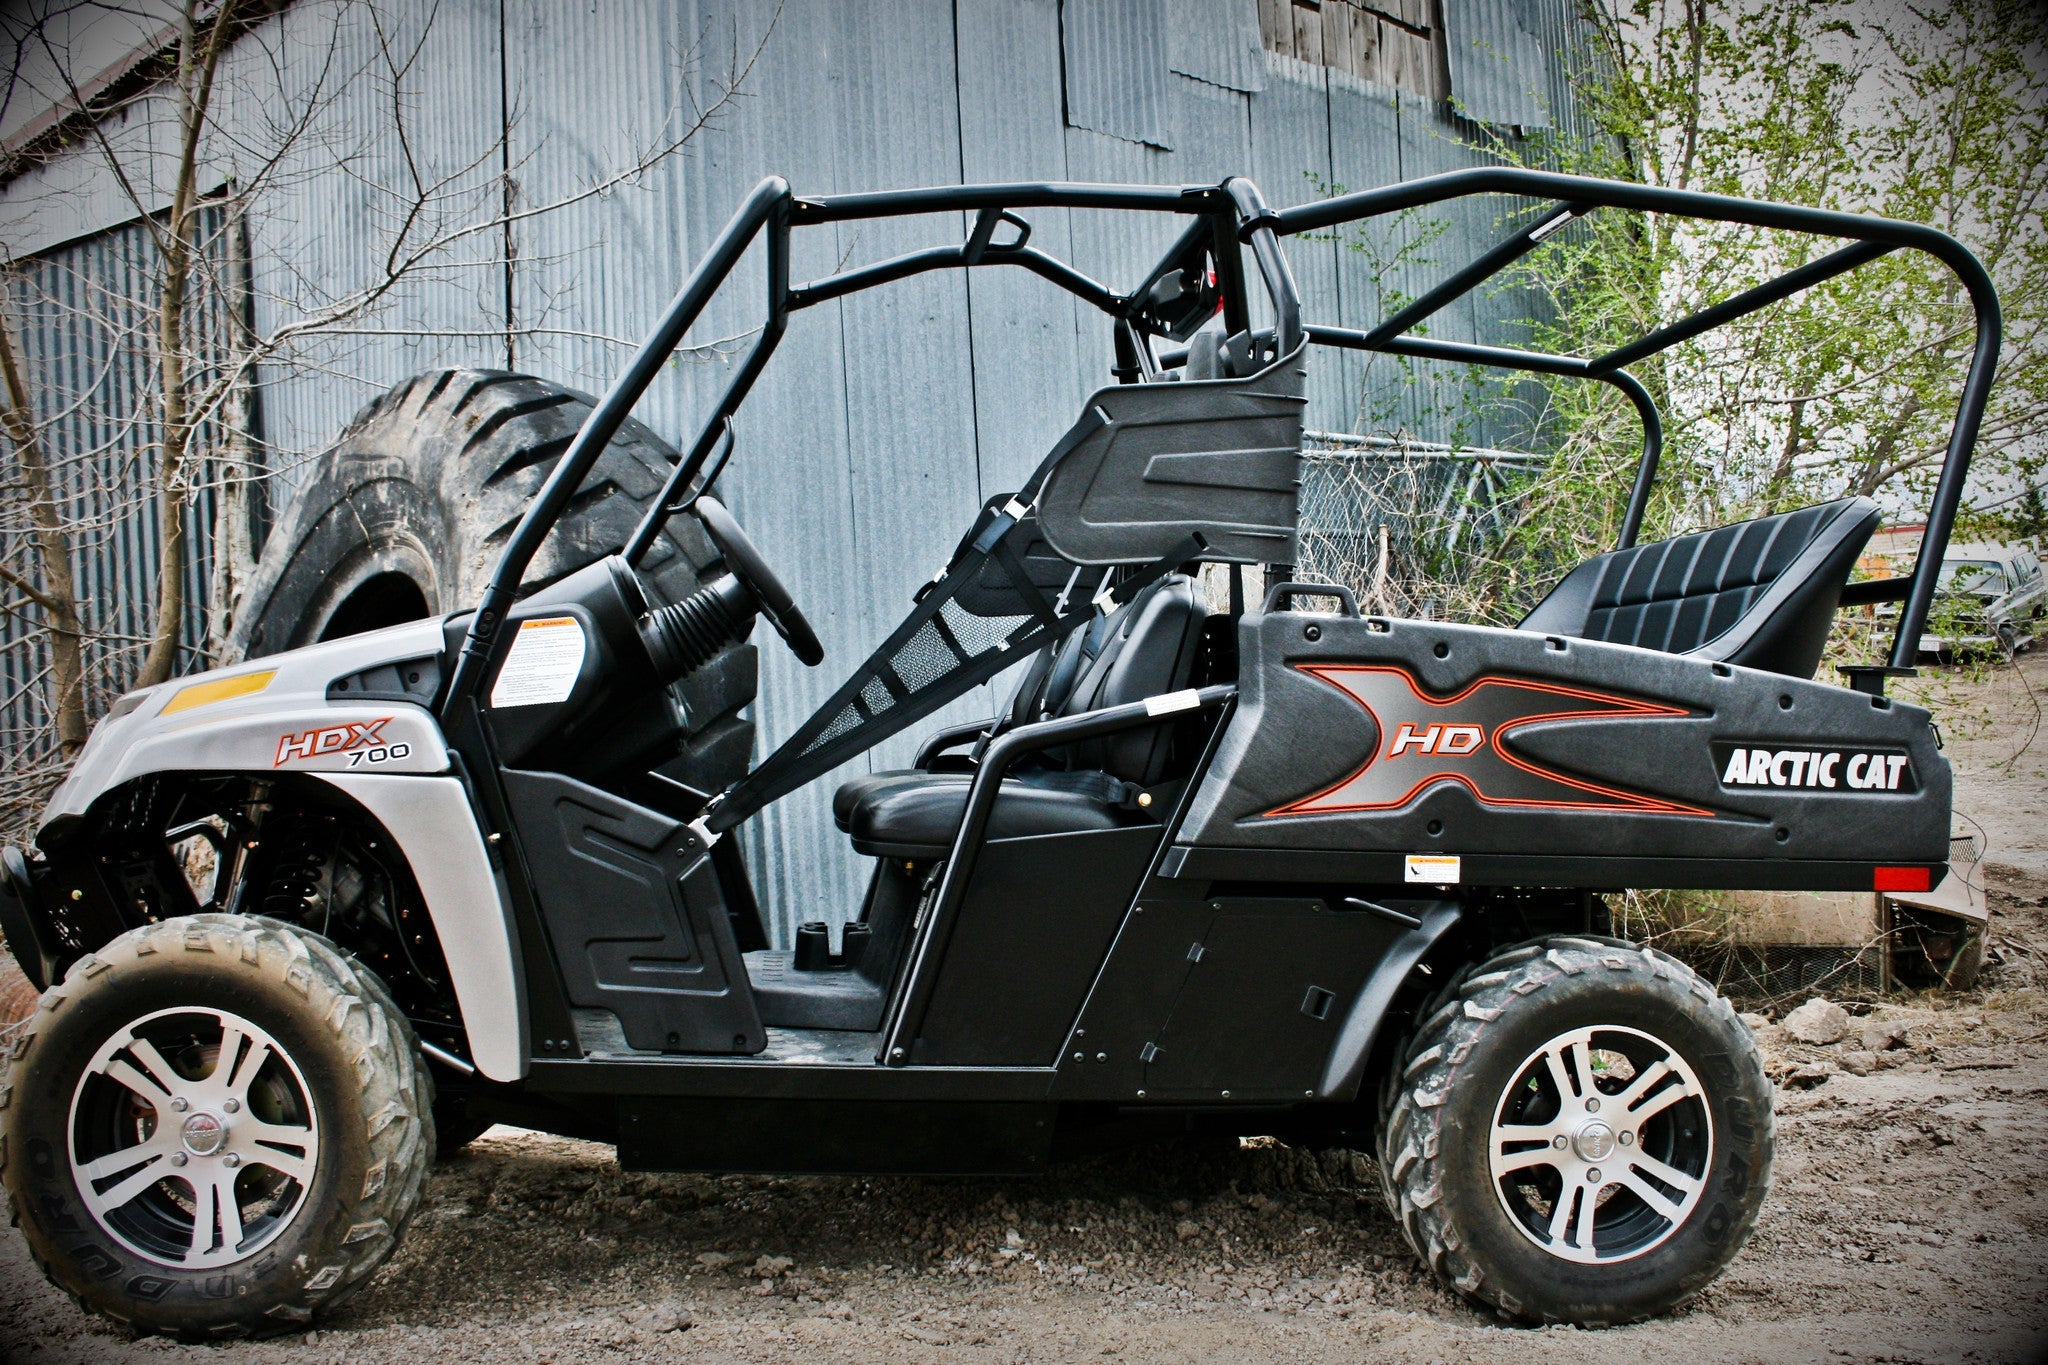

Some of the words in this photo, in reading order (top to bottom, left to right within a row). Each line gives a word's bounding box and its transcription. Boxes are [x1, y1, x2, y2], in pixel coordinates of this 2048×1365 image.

[274, 717, 394, 768] HDX
[345, 743, 411, 768] 700
[1386, 723, 1486, 760] HD
[1722, 749, 1840, 787] ARCTIC
[1846, 754, 1908, 789] CAT
